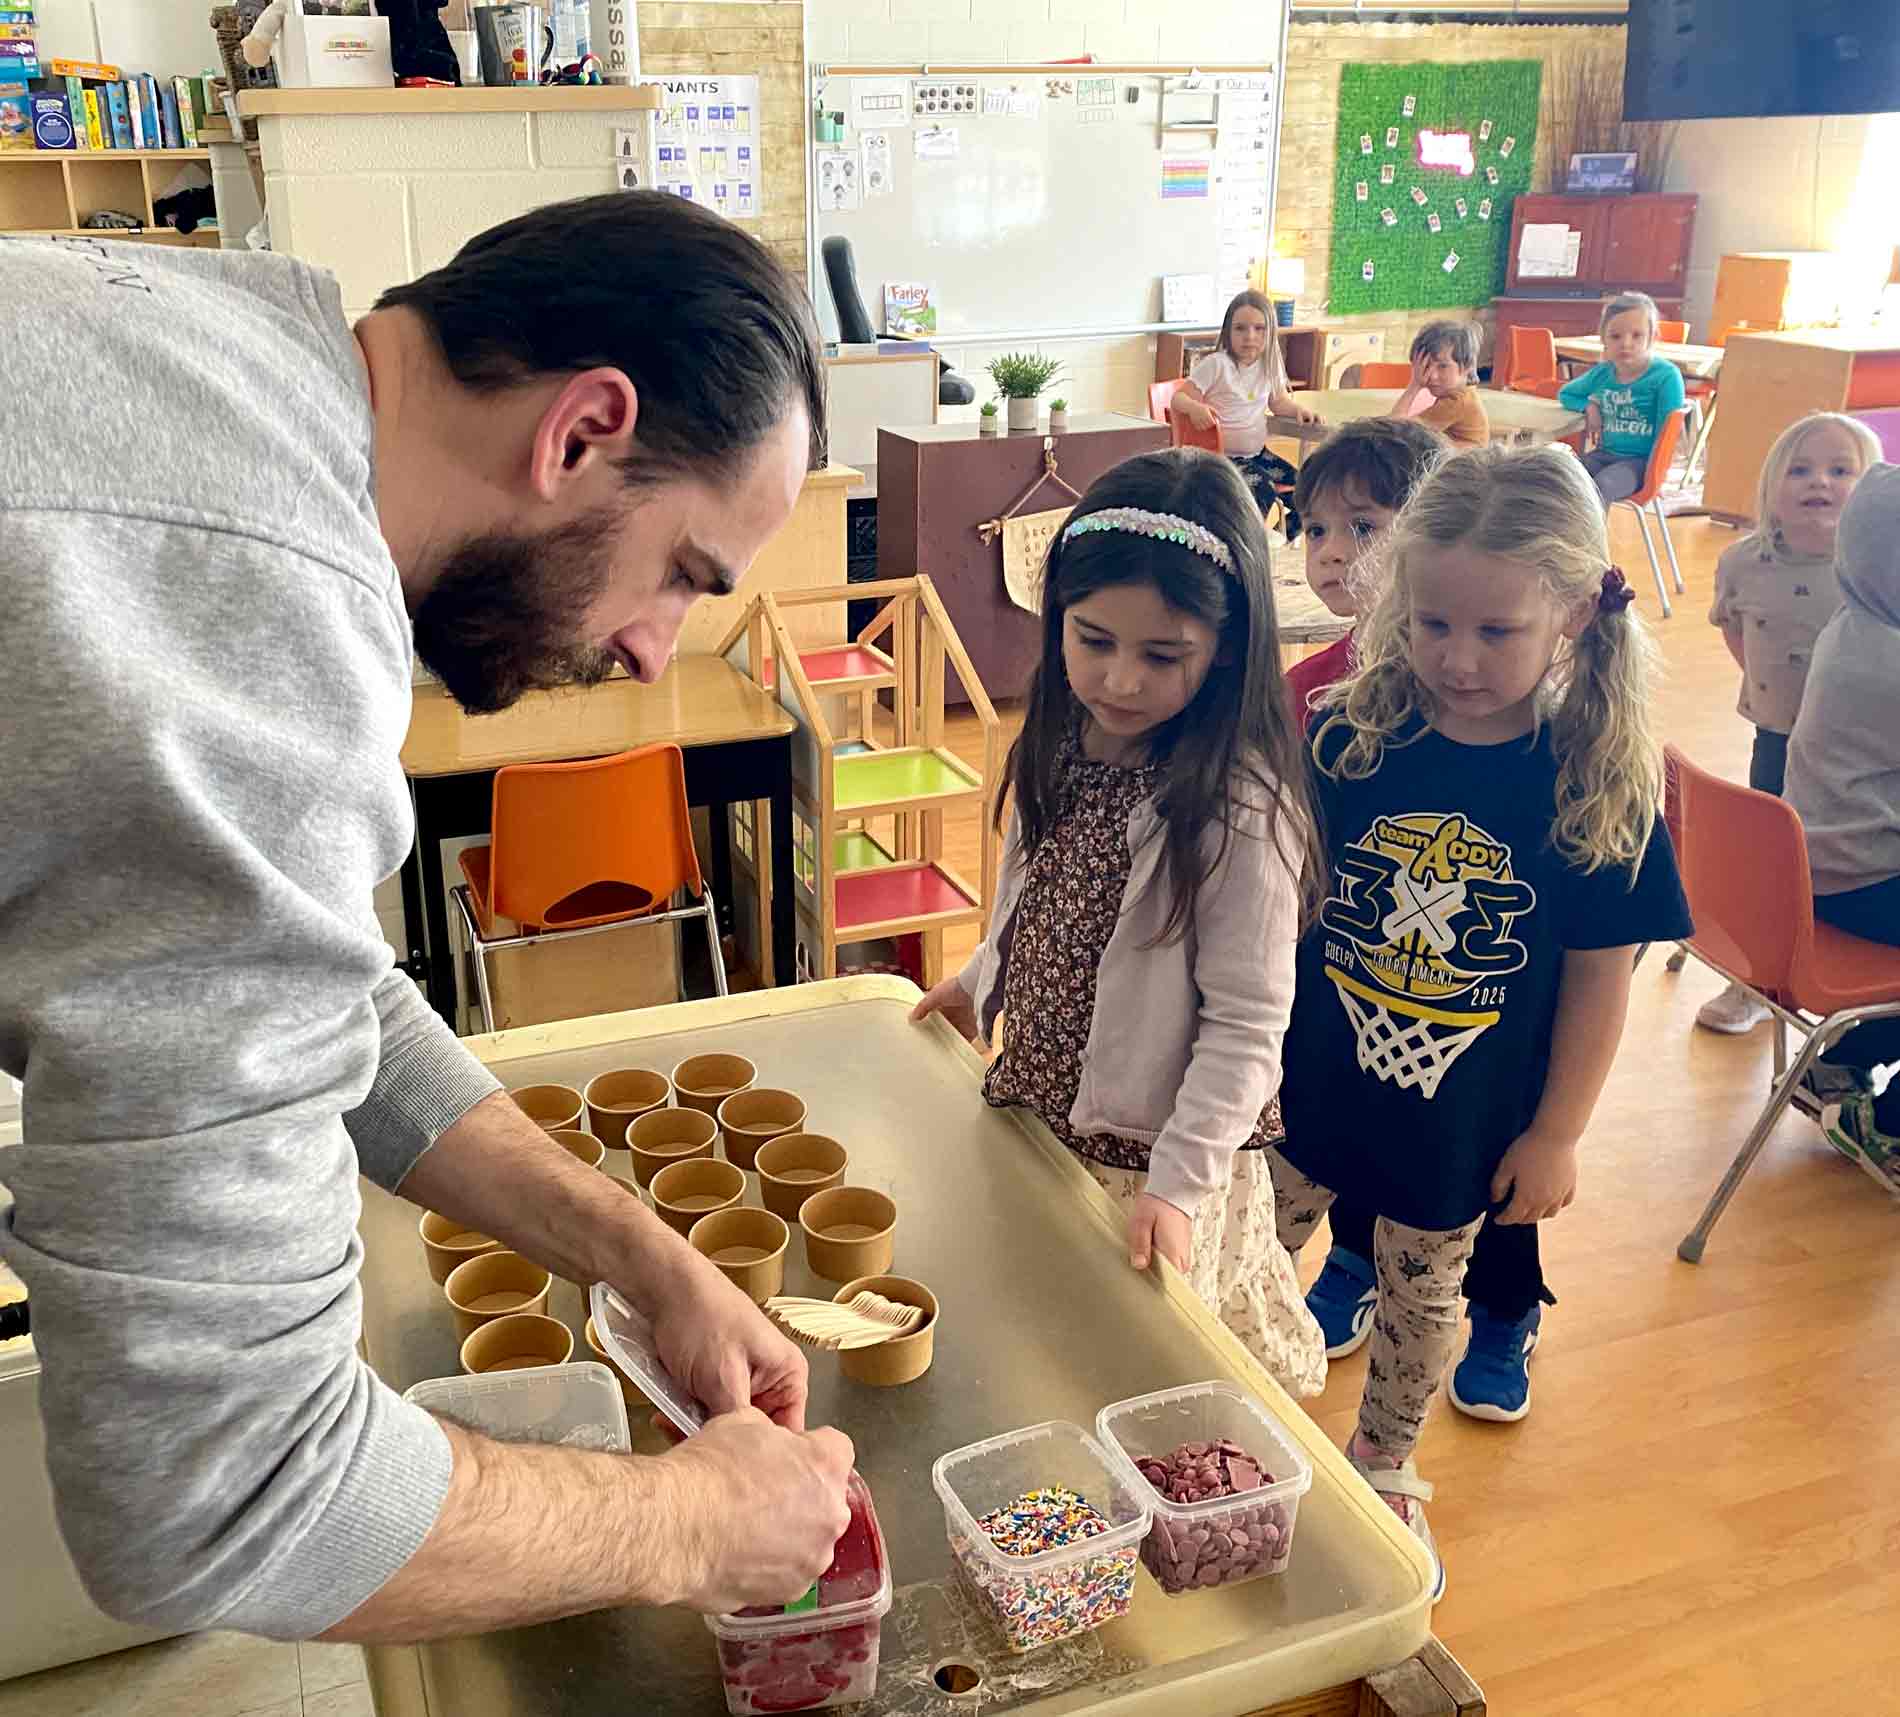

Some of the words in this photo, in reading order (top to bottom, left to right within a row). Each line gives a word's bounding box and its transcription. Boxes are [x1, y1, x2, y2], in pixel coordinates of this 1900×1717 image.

[1377, 819, 1431, 849] team
[1324, 940, 1356, 971] GUELPH
[1373, 950, 1454, 987] TOURNAMENT
